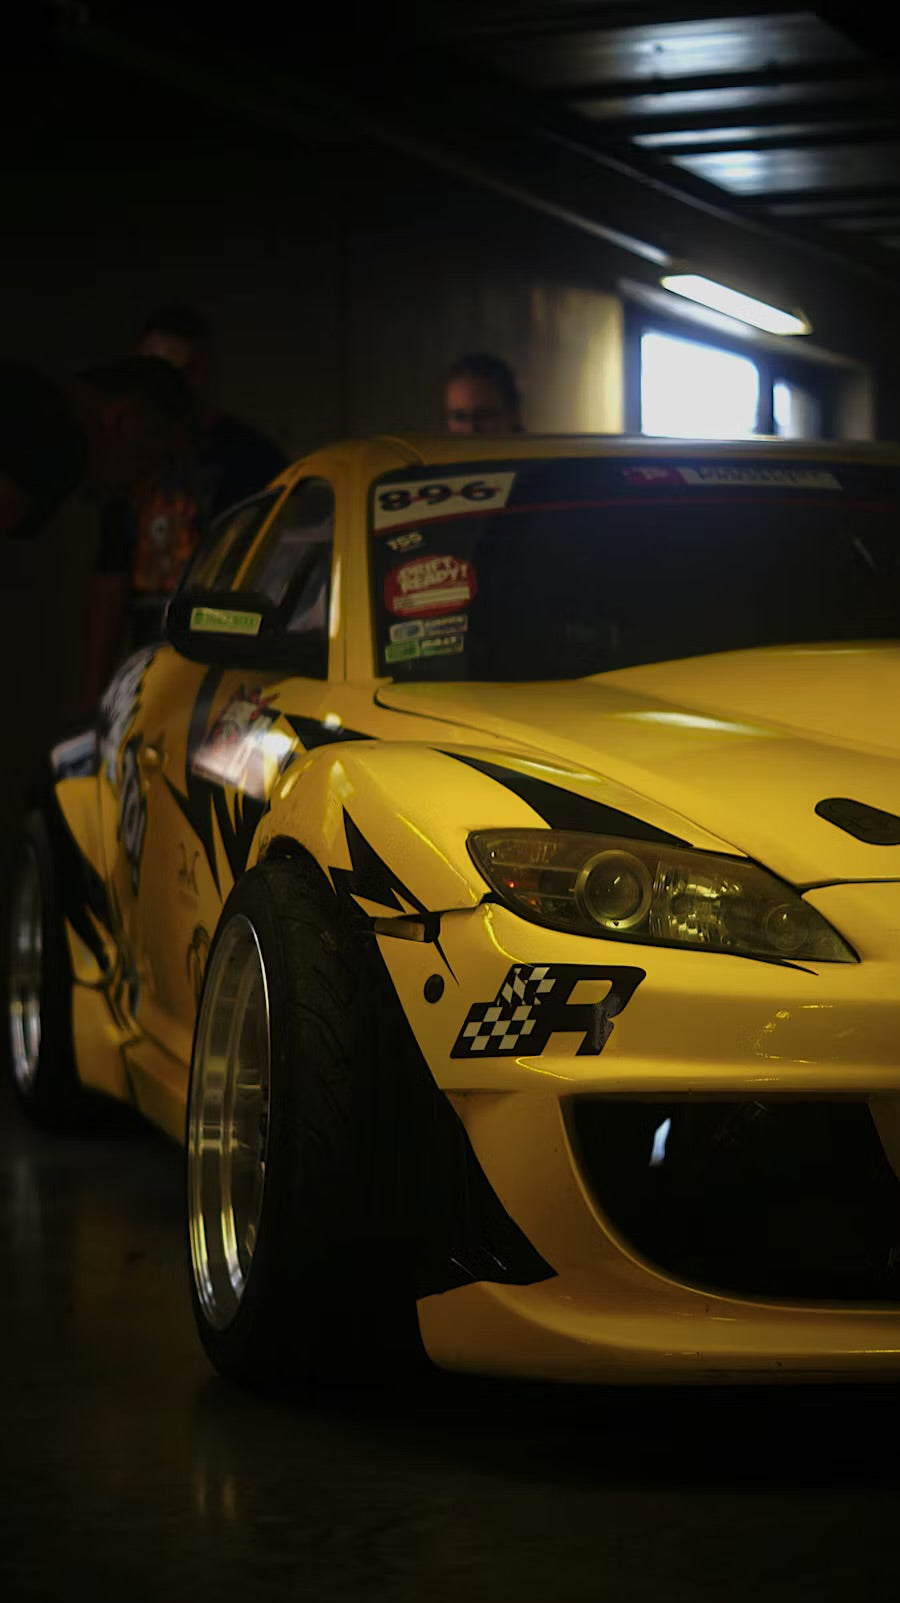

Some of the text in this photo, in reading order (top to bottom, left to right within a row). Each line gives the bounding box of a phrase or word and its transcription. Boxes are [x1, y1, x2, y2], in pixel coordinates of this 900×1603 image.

[379, 480, 496, 512] 896
[396, 555, 454, 580] DRIFT
[399, 564, 469, 593] READY!
